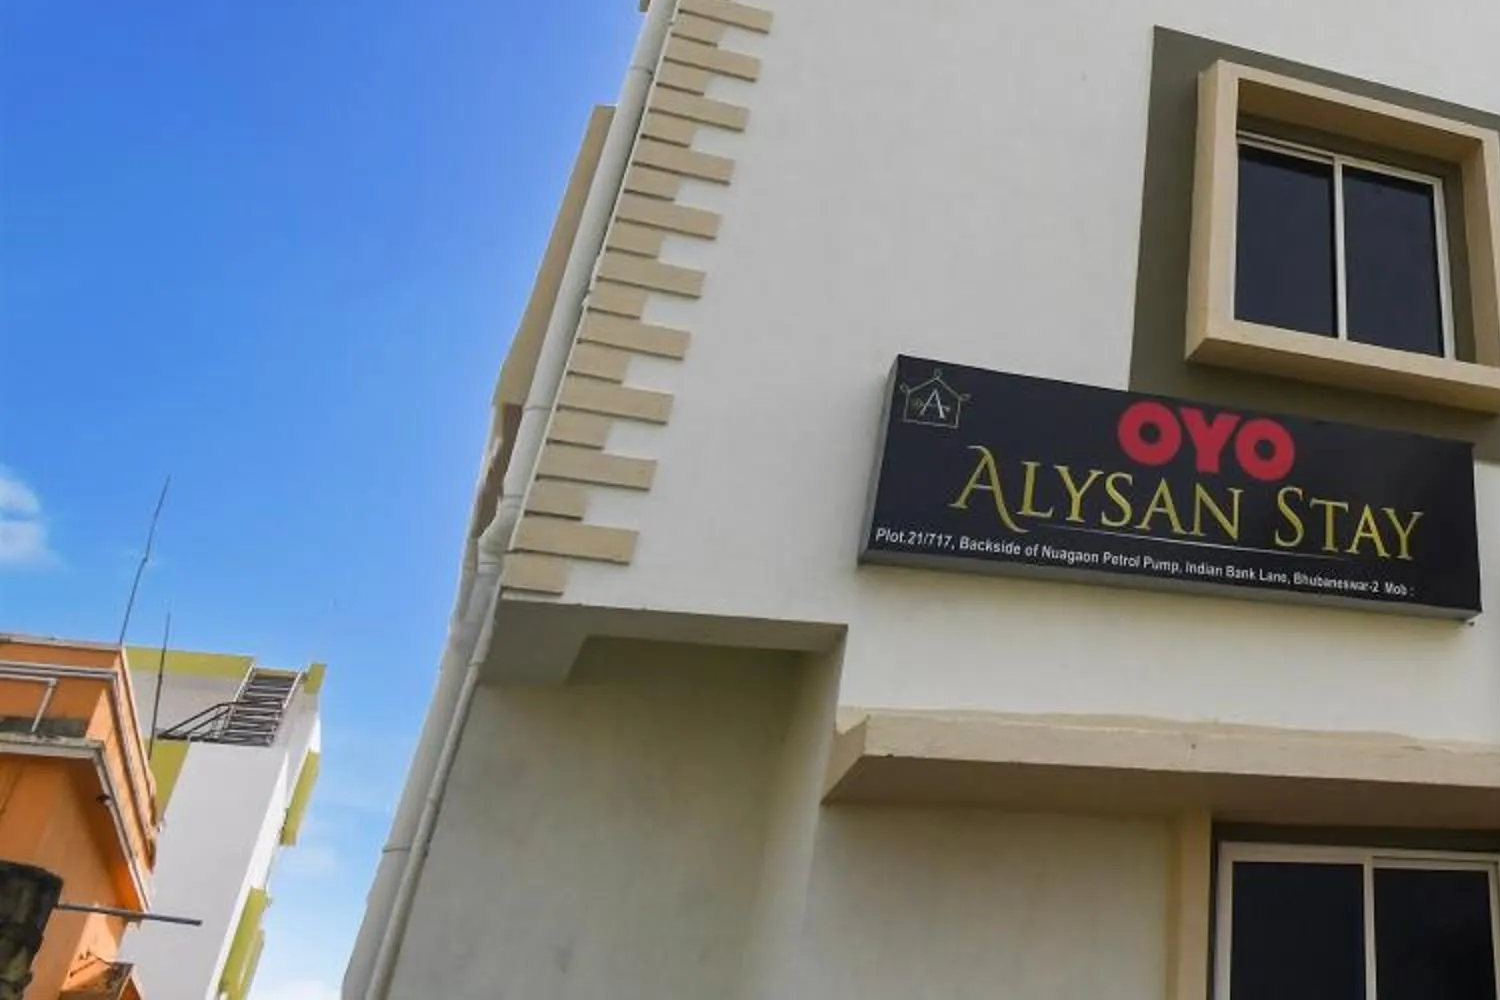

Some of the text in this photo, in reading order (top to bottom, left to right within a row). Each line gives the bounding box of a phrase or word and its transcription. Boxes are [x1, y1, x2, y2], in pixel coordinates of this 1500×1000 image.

[1117, 401, 1295, 482] OYO
[949, 444, 1424, 560] ALYSAN STAY
[960, 535, 1021, 555] Backside
[1025, 543, 1038, 557] of
[1041, 544, 1099, 565] Nuagaon
[1102, 551, 1141, 568] Petrol
[1143, 555, 1183, 574] Pump,
[1185, 562, 1223, 577] Indian
[1226, 565, 1254, 580] Bank
[1259, 568, 1291, 585] Lane,
